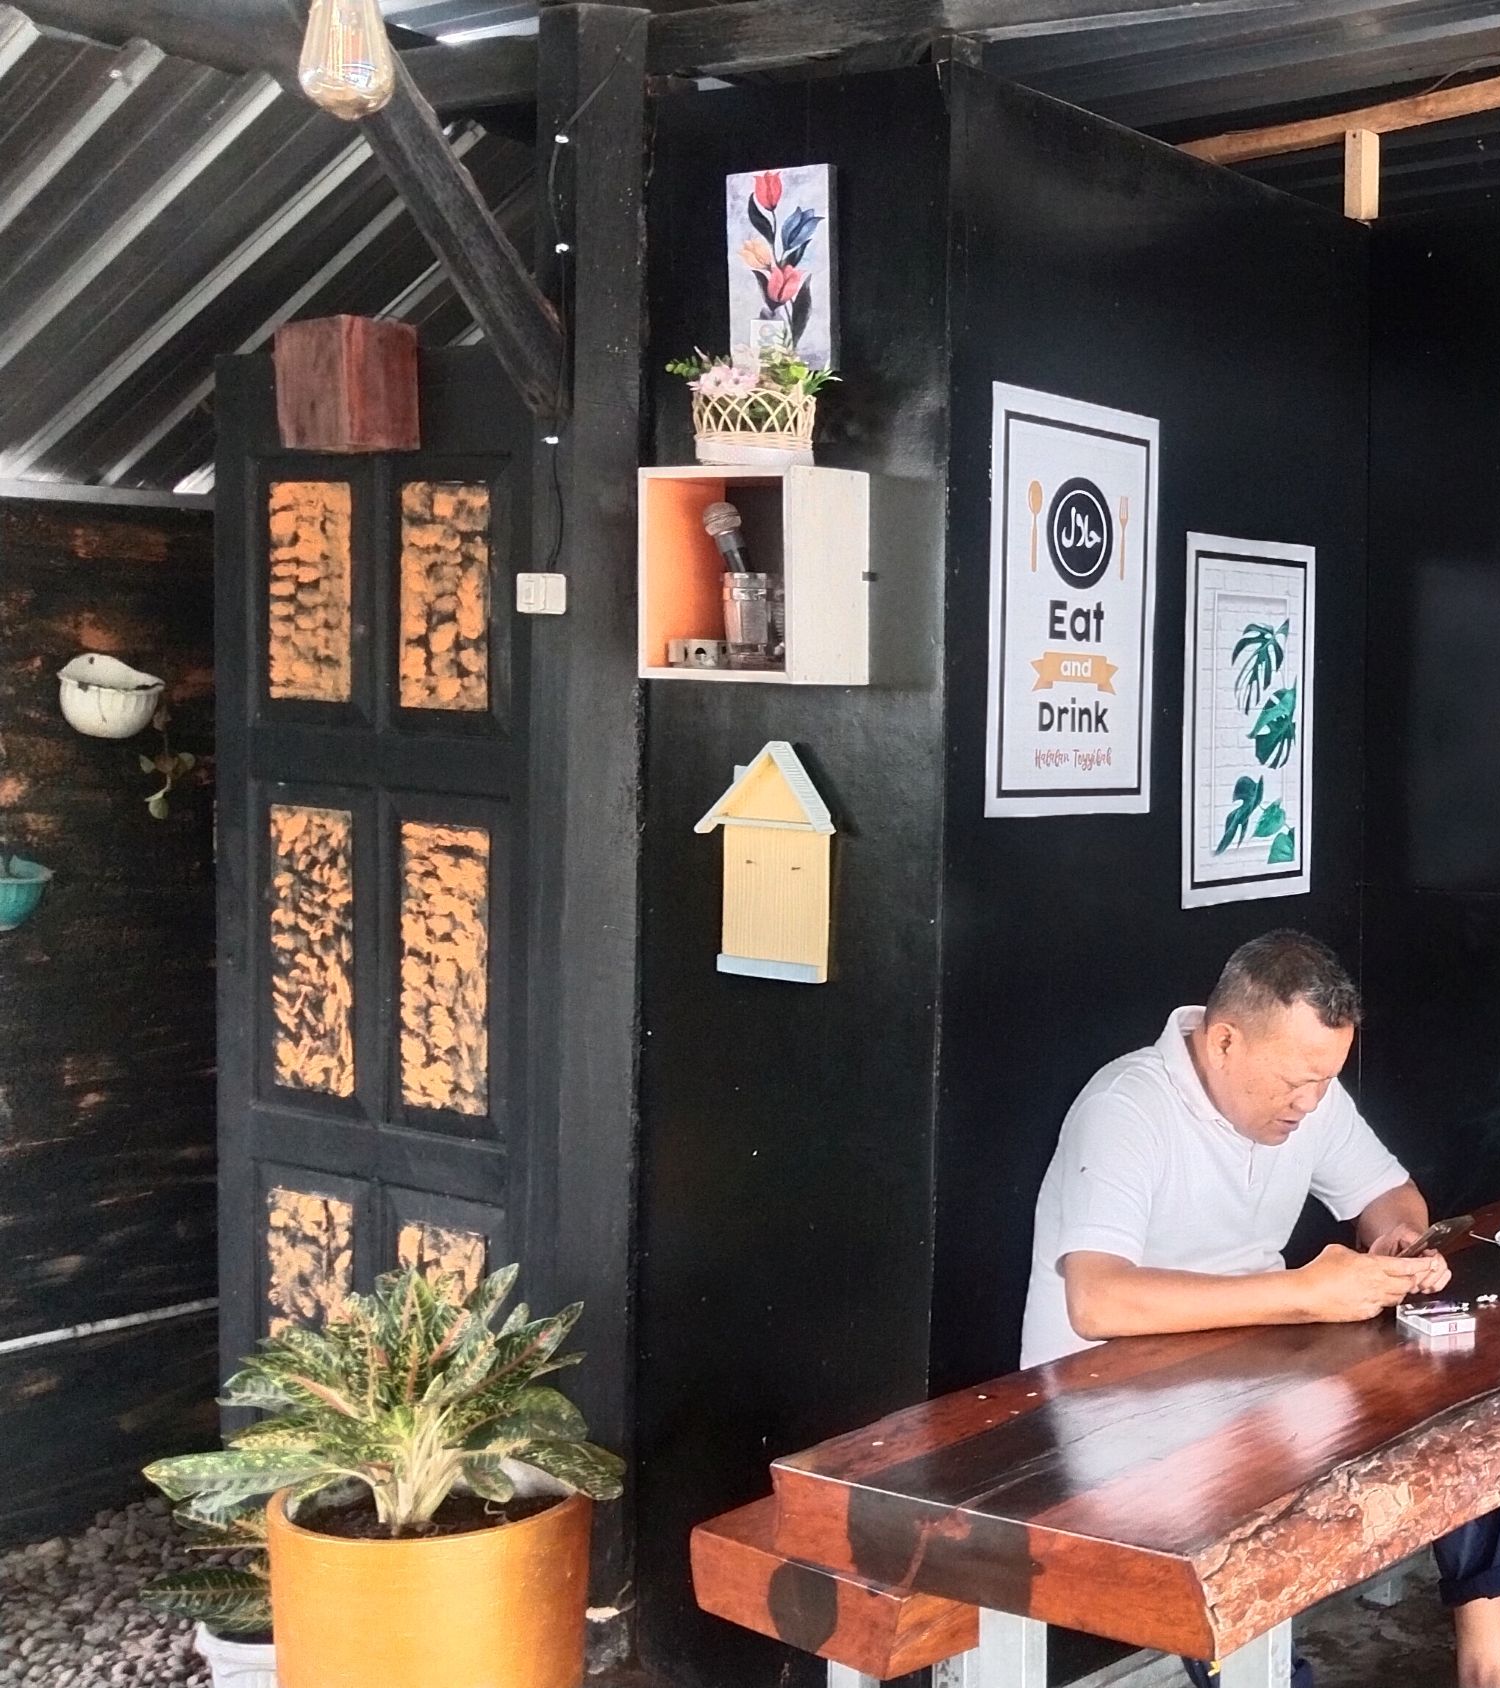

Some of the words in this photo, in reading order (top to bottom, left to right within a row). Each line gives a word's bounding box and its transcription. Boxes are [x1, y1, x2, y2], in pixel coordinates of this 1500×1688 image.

[1061, 506, 1101, 549] حلال
[1048, 599, 1105, 643] Eat
[1059, 657, 1092, 678] and
[1038, 697, 1109, 733] Drink
